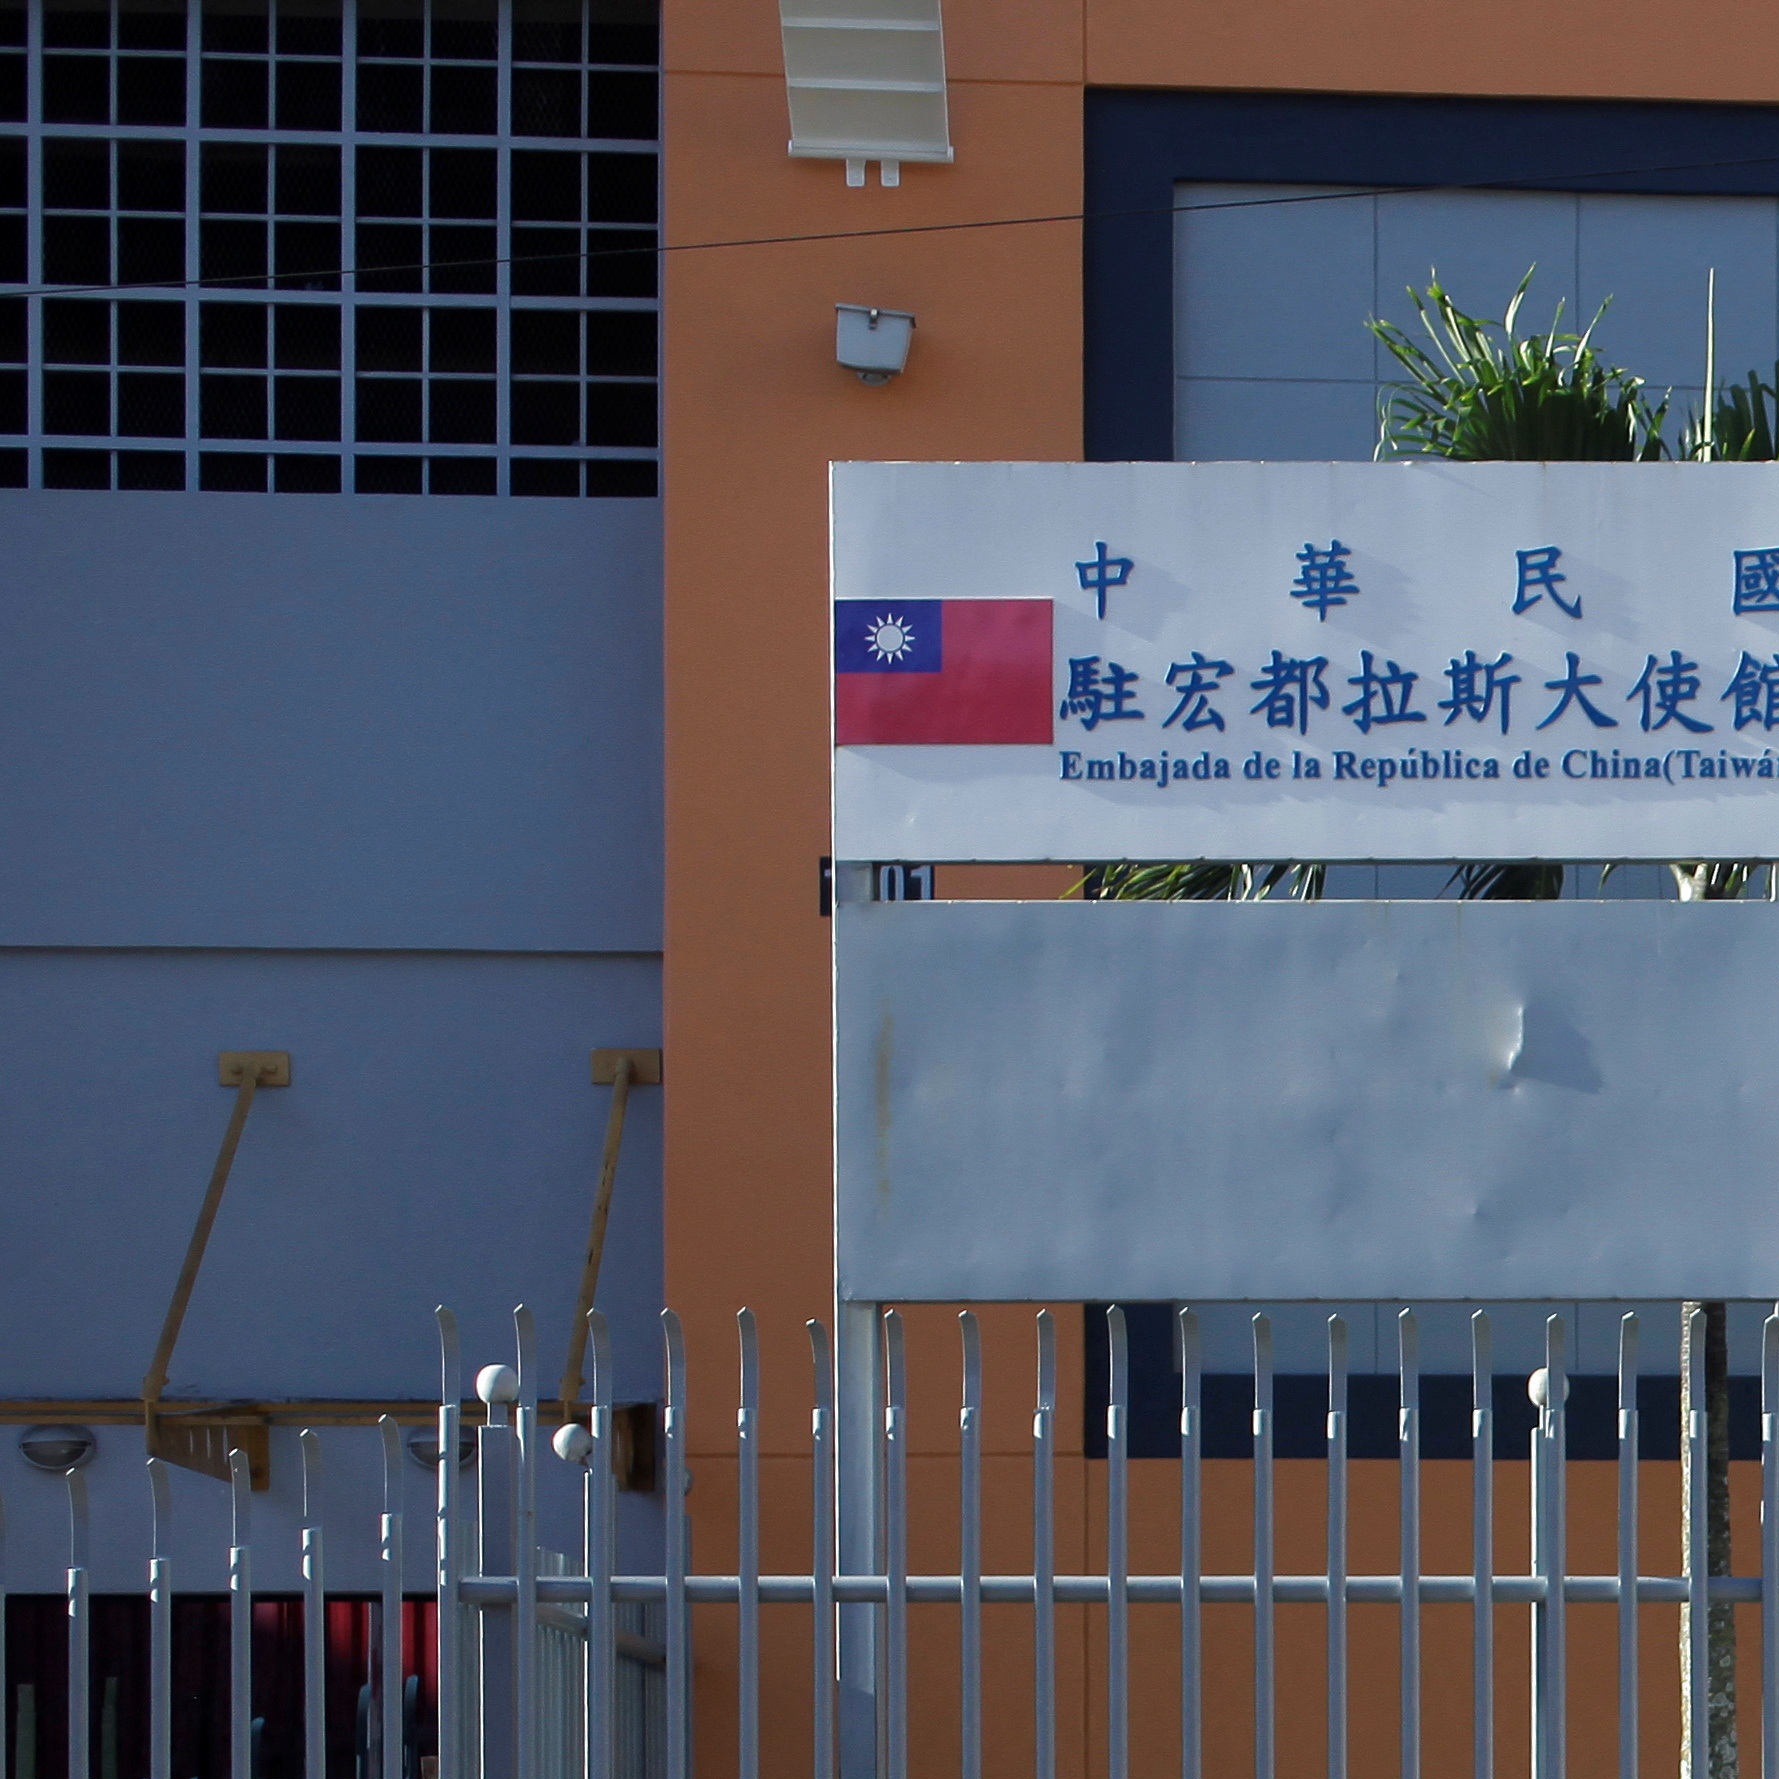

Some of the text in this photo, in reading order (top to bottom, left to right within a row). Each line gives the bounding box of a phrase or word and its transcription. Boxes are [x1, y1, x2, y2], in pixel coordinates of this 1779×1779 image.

[1059, 750, 1231, 787] Embajada
[1242, 750, 1281, 780] de
[1292, 750, 1322, 780] la
[1332, 747, 1501, 787] República
[1512, 750, 1550, 780] de
